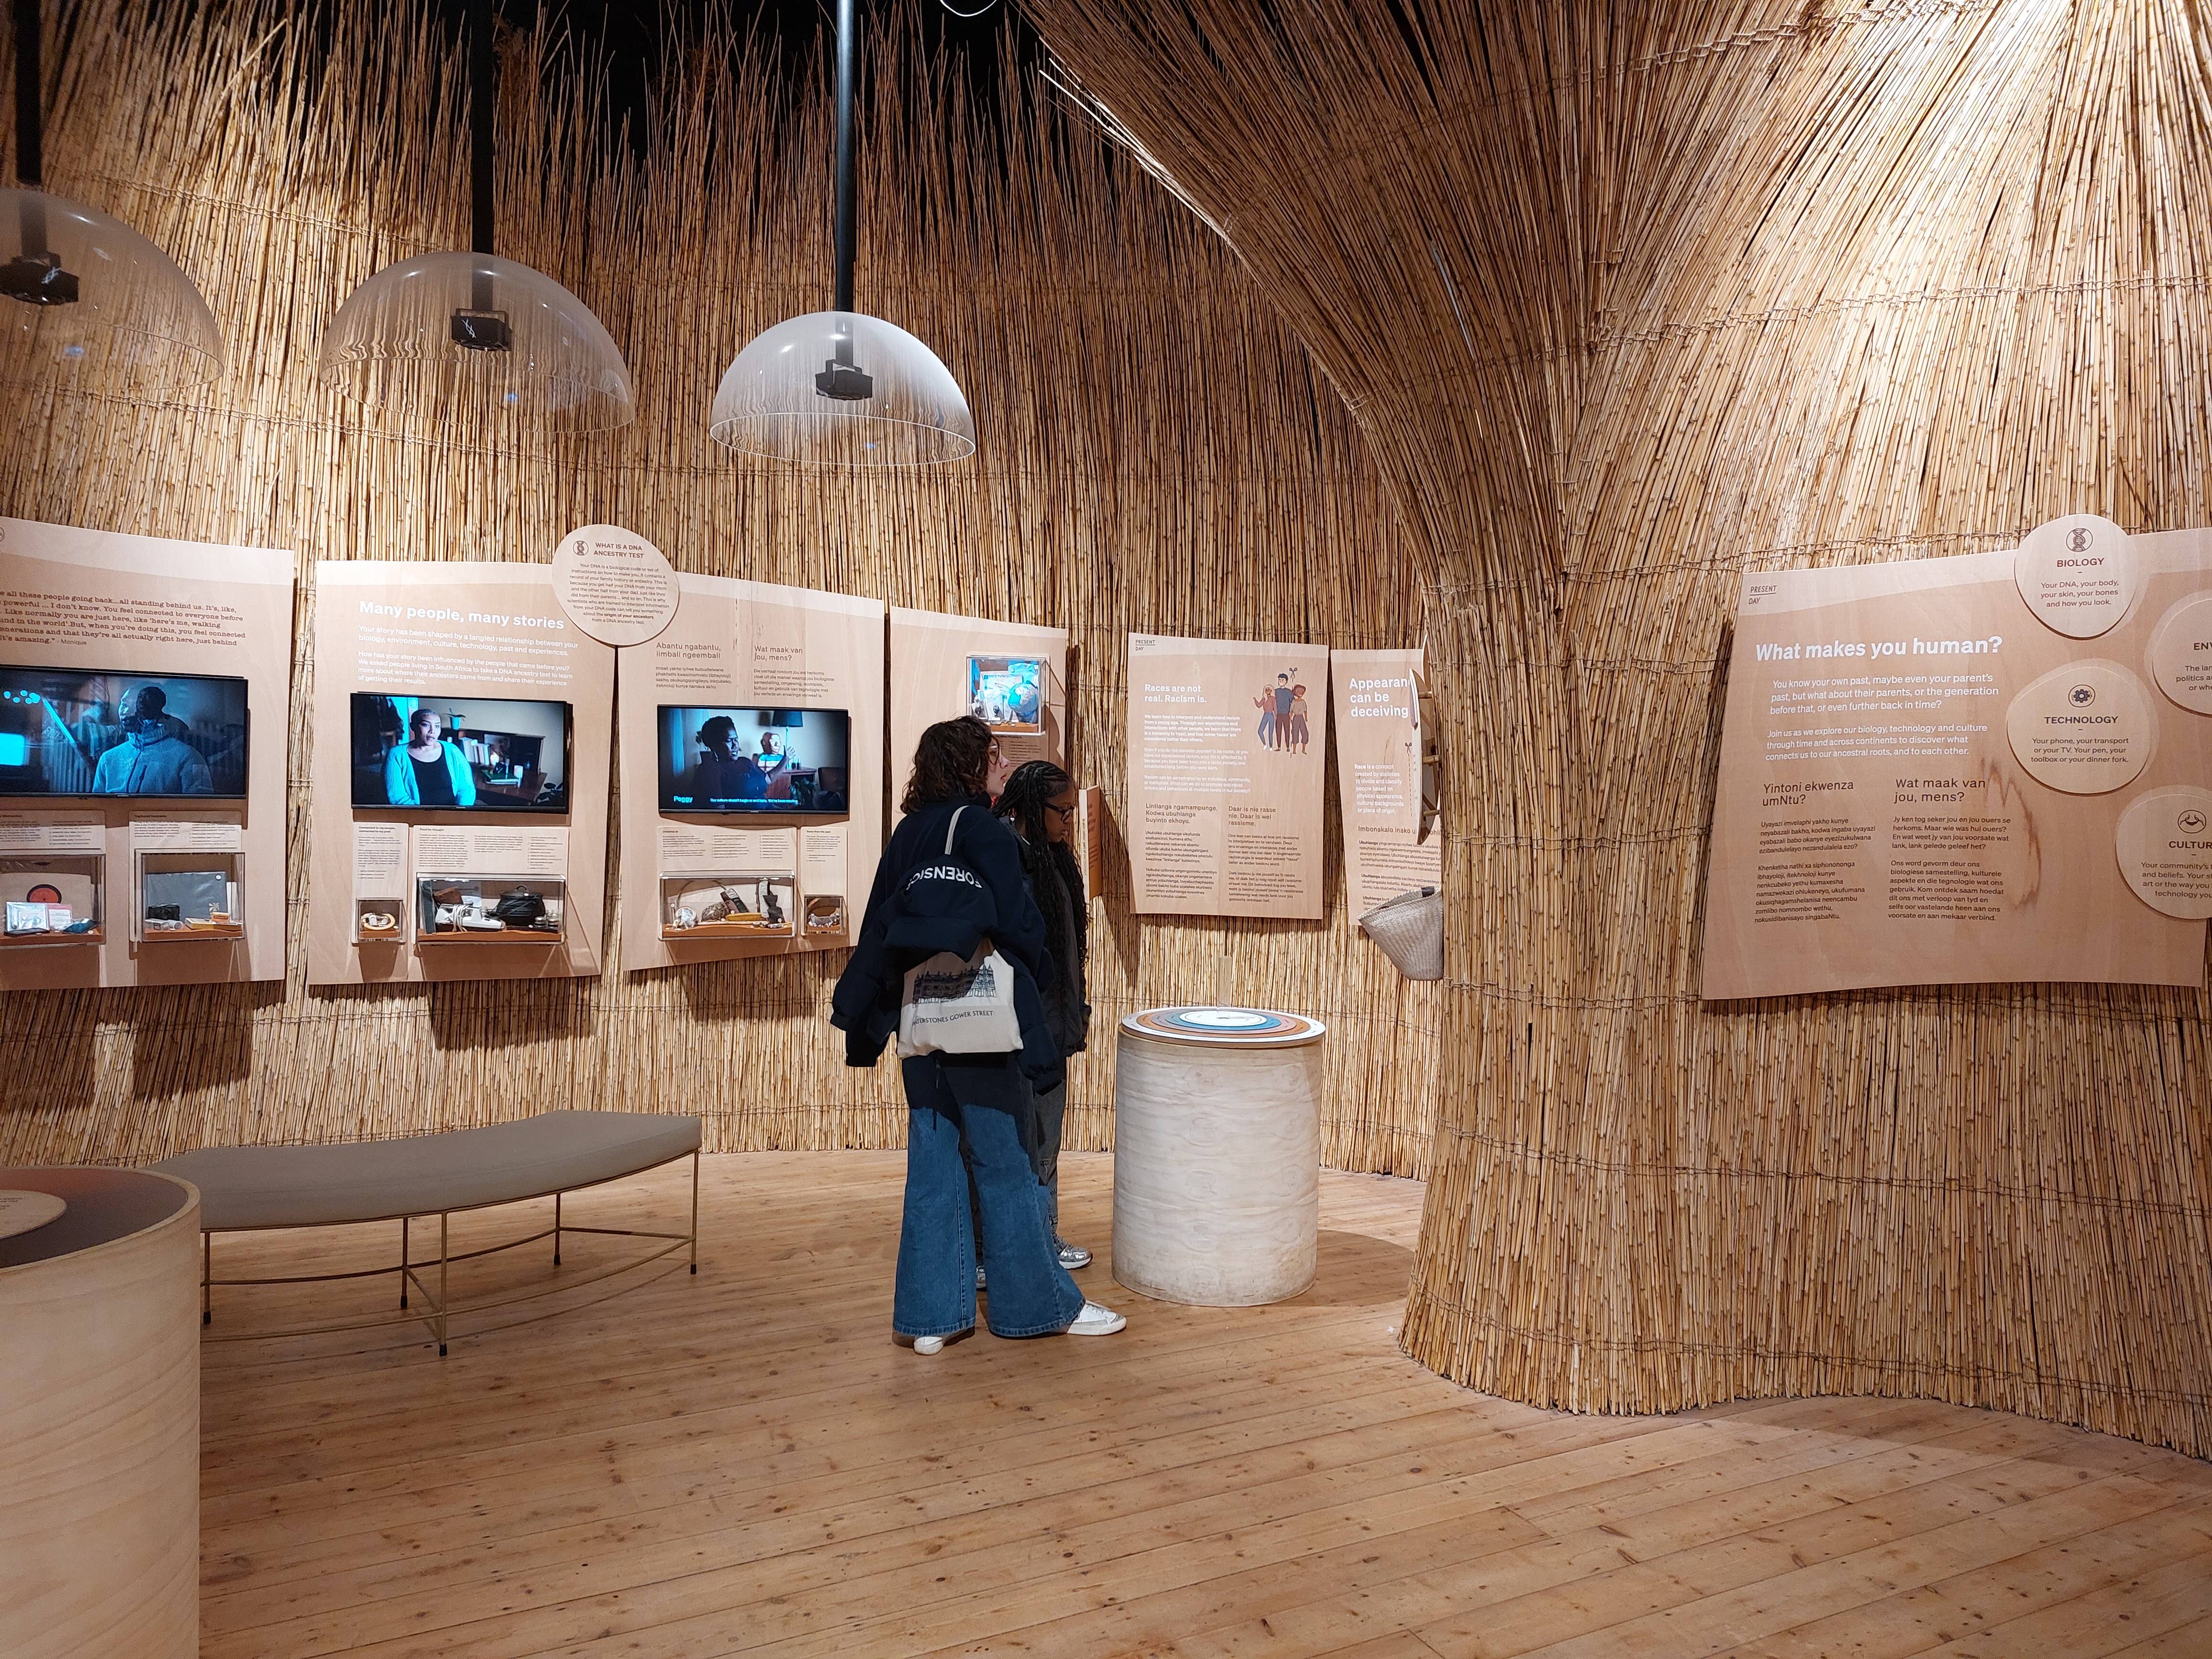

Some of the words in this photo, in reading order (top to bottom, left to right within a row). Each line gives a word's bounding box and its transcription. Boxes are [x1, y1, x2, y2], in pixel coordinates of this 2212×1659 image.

[2057, 557, 2105, 567] BIOLOGY
[1750, 585, 1777, 593] PRESENT
[94, 596, 129, 605] back...all
[131, 599, 165, 608] standing
[165, 601, 191, 609] behind
[1748, 597, 1760, 605] DAY
[360, 600, 403, 618] Many
[407, 608, 464, 623] people,
[468, 612, 509, 627] many
[512, 615, 564, 629] stories
[376, 627, 395, 635] story
[409, 629, 427, 637] been
[427, 630, 453, 639] shaped
[454, 632, 463, 641] by
[469, 634, 495, 642] tangled
[496, 636, 534, 646] relationship
[535, 639, 563, 647] between
[685, 643, 721, 652] ngabantu,
[1756, 642, 1801, 661] What
[1805, 640, 1866, 658] makes
[1871, 641, 1906, 660] you
[1913, 635, 2002, 654] human?
[753, 653, 767, 661] jou,
[1773, 679, 1787, 688] You
[1789, 679, 1811, 688] know
[1811, 679, 1830, 688] your
[1850, 675, 1871, 686] past,
[1872, 675, 1903, 686] maybe
[1929, 675, 1951, 685] your
[1953, 673, 1993, 684] parent's
[2176, 675, 2204, 683] politics
[1144, 684, 1170, 692] Races
[1144, 694, 1162, 702] real.
[1164, 694, 1195, 703] Racism
[1197, 695, 1206, 703] is.
[1349, 694, 1371, 703] can
[1374, 691, 1389, 702] be
[1350, 705, 1408, 718] deceiving
[2044, 716, 2118, 724] TECHNOLOGY
[1763, 783, 1802, 794] Yintoni
[1804, 781, 1854, 791] ekwenza
[1895, 778, 1919, 788] Wat
[1923, 777, 1958, 788] maak
[1962, 780, 1985, 788] van
[1762, 794, 1806, 807] umNtu?
[1894, 794, 1917, 804] jou,
[1921, 791, 1965, 802] mens?
[2168, 841, 2212, 849] CULTUR
[2155, 890, 2198, 899] technology
[950, 1012, 972, 1021] GOWER
